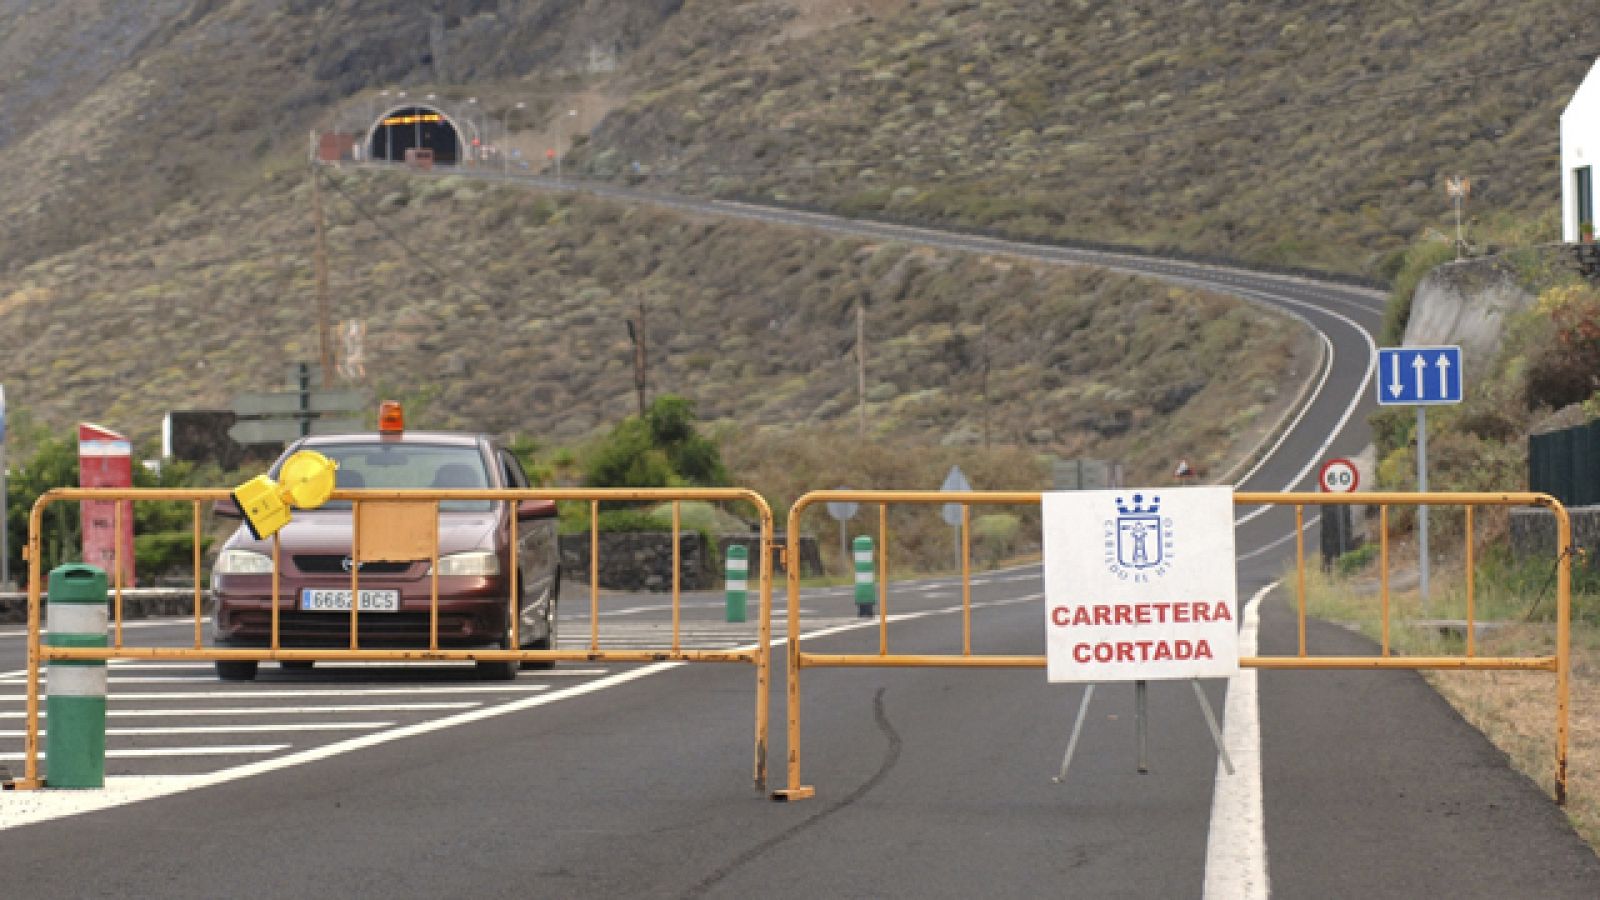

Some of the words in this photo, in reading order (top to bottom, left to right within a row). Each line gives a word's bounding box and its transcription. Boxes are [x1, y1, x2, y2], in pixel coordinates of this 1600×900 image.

[1327, 471, 1351, 486] 60
[361, 591, 394, 609] BCS
[1051, 601, 1232, 626] CARRETERA
[1072, 639, 1213, 663] CORTADA
